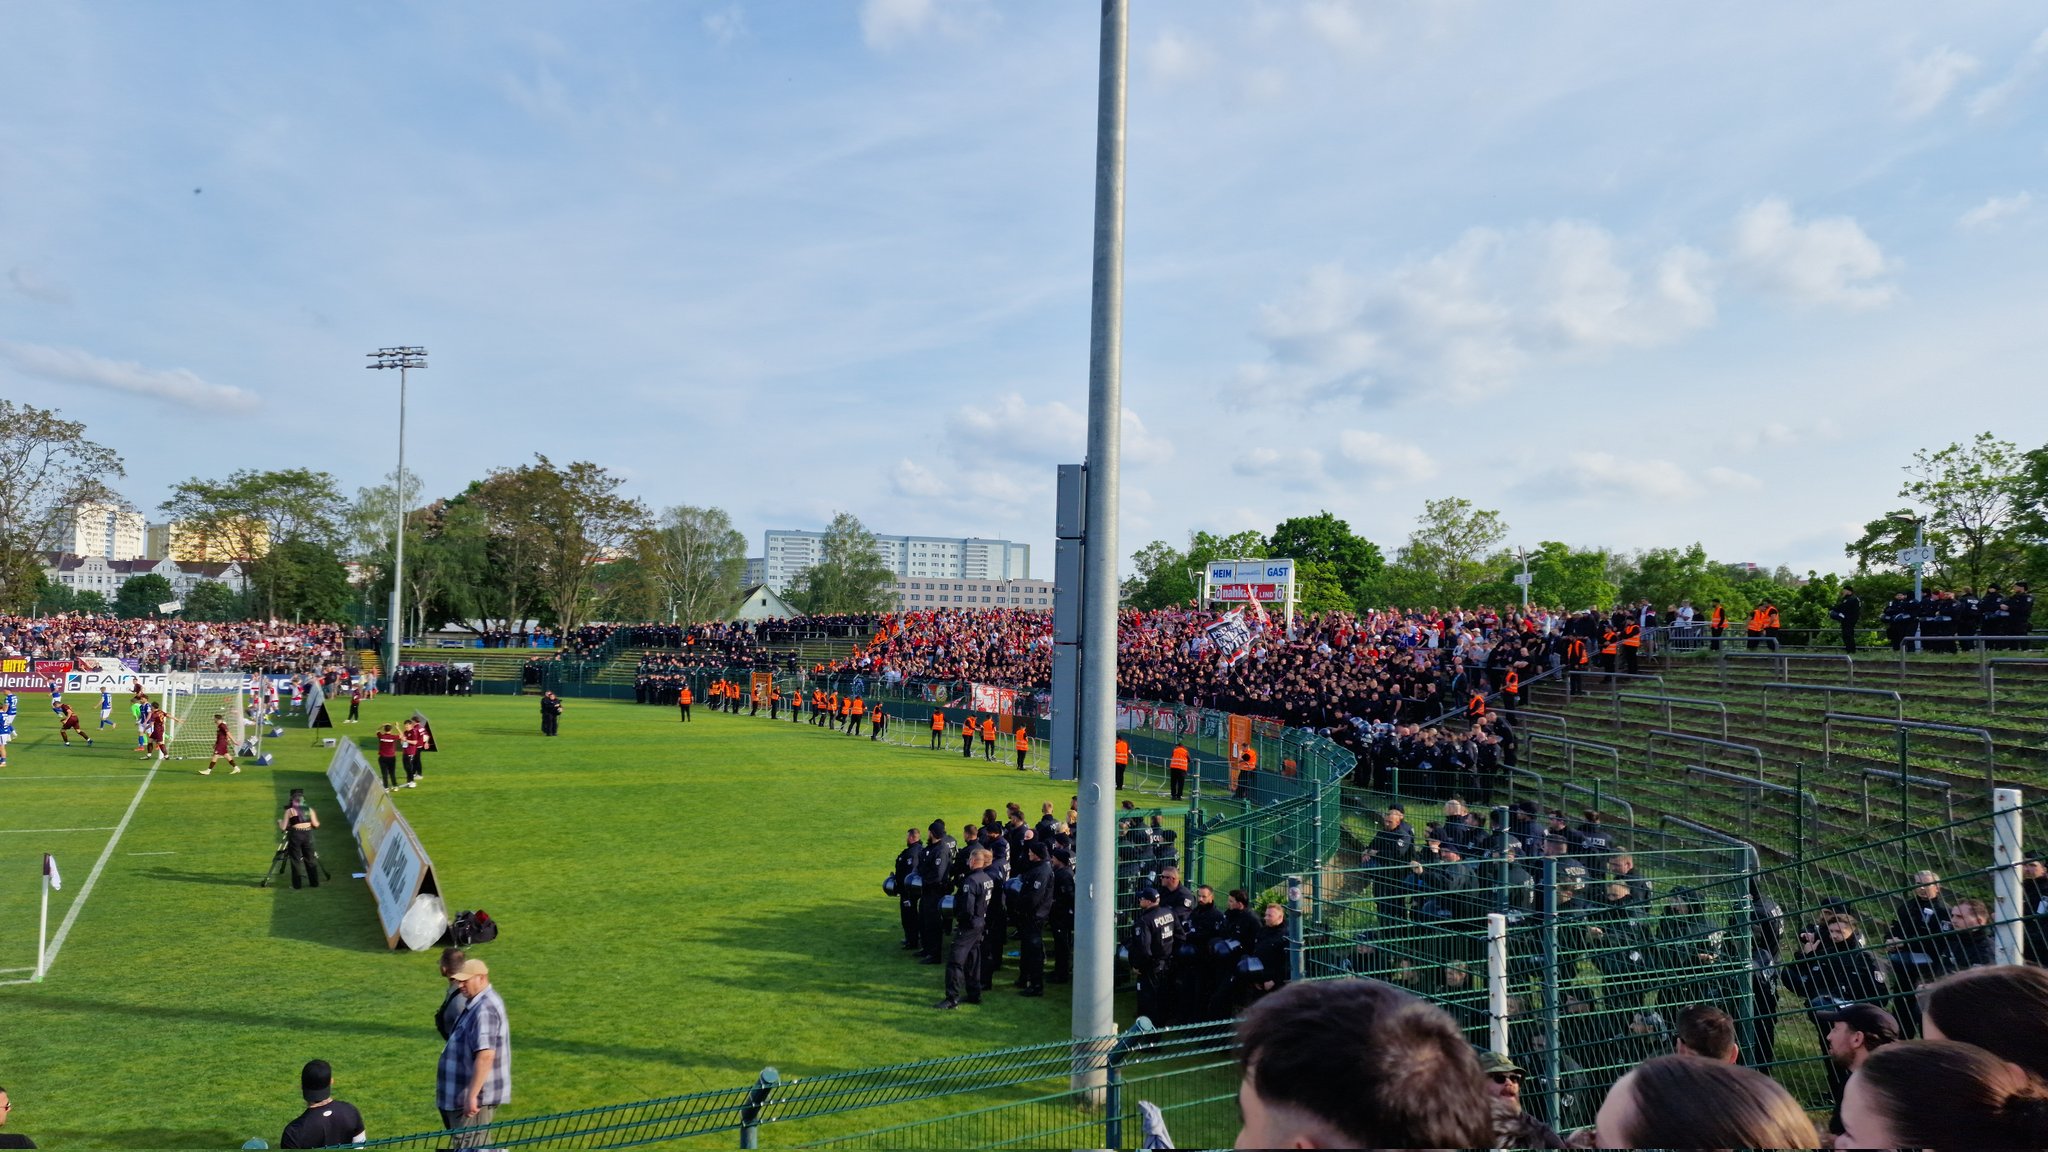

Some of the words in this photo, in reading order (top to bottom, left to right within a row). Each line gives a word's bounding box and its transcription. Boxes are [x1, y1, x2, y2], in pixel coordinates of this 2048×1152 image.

[1921, 548, 1929, 559] C
[1213, 569, 1232, 578] HEIM
[1267, 567, 1288, 577] GAST
[1223, 585, 1259, 598] nahkaf
